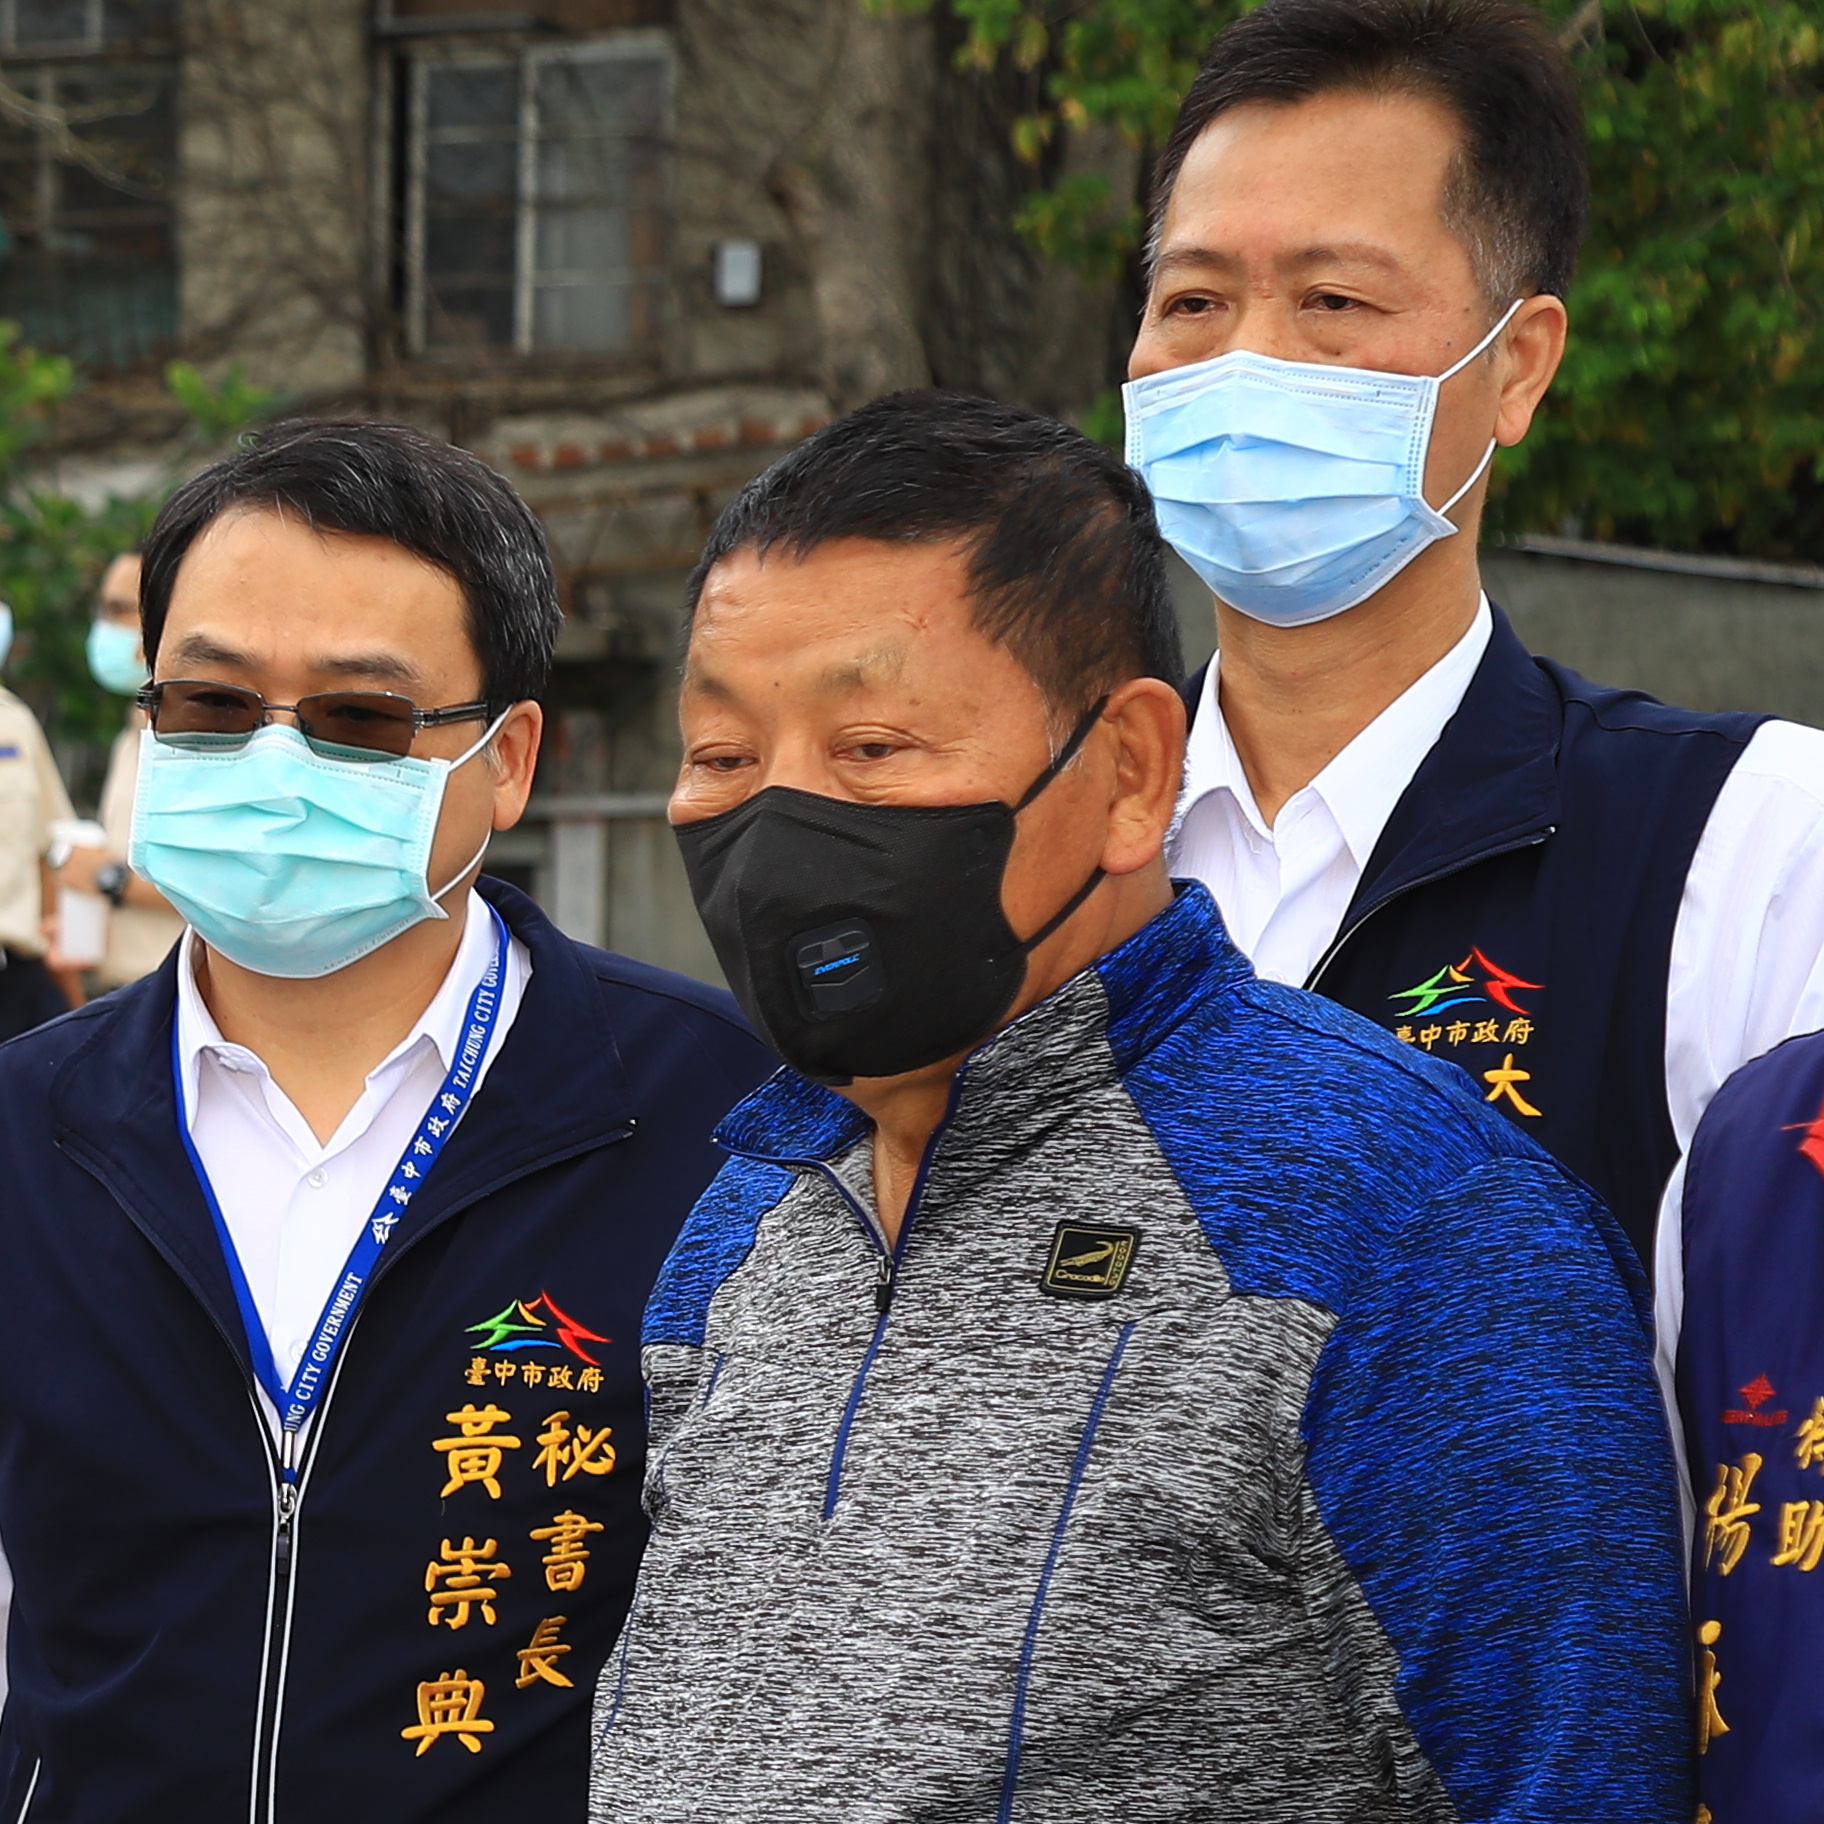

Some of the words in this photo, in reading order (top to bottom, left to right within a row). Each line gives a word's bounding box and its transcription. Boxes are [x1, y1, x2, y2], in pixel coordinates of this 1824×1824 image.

[453, 1024, 487, 1089] TAICHUNG
[474, 989, 496, 1023] CITY
[1483, 1053, 1543, 1117] 大
[389, 1091, 462, 1206] 臺中市政府
[295, 1363, 322, 1401] CITY
[311, 1272, 363, 1363] GOVERNMENT
[464, 1356, 606, 1392] 臺中市政府
[400, 1403, 521, 1757] 黃崇典
